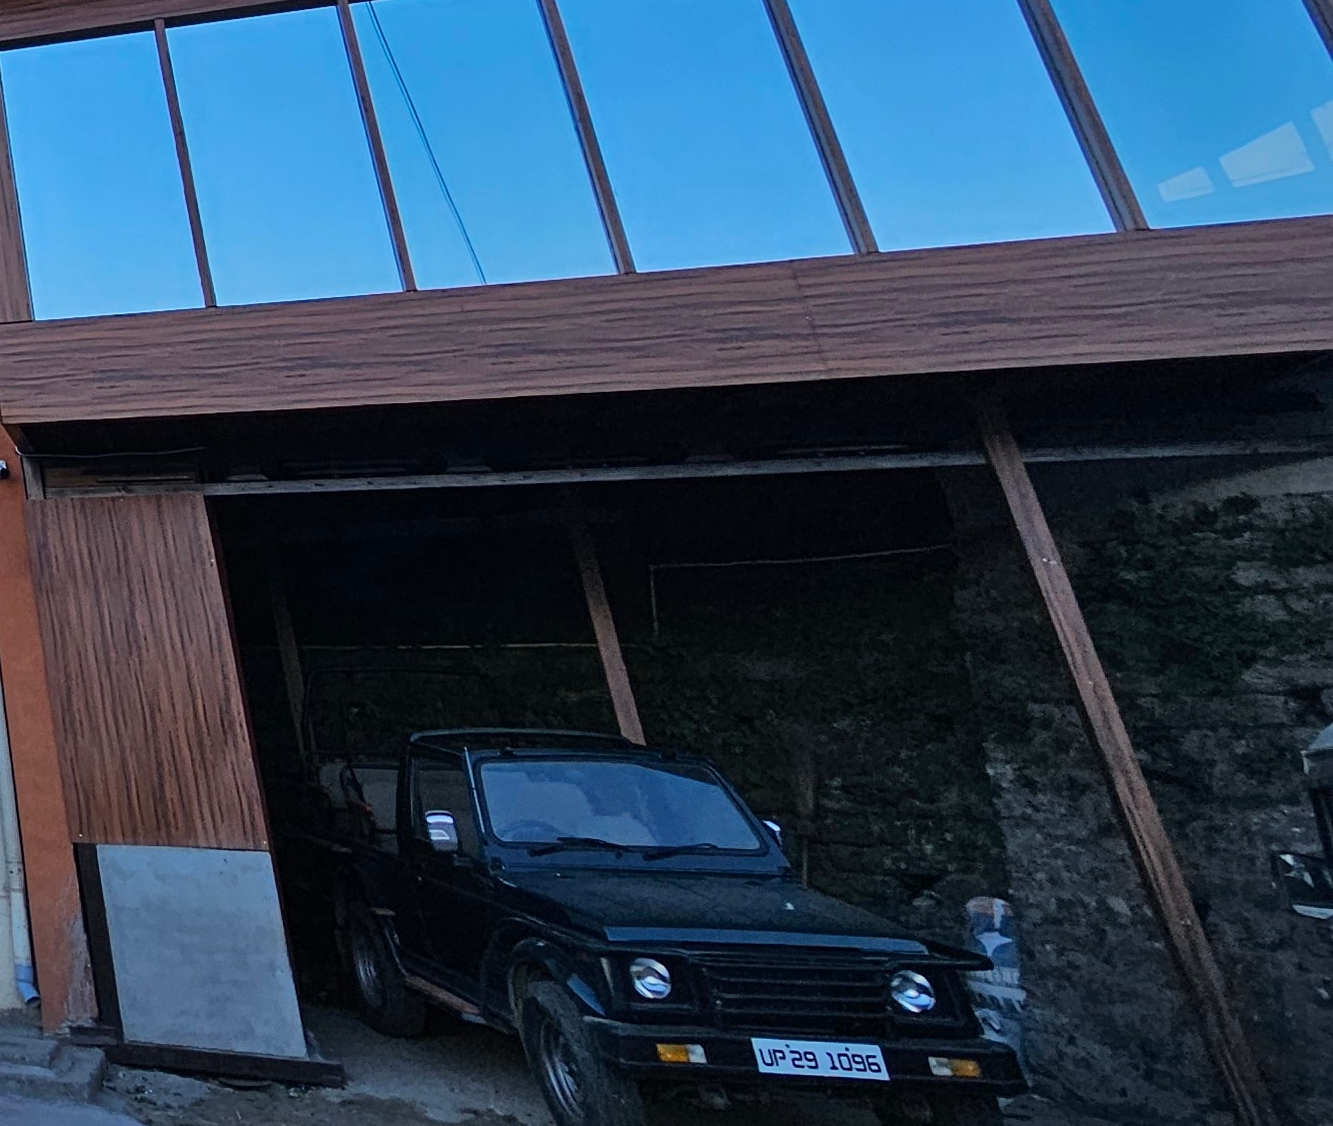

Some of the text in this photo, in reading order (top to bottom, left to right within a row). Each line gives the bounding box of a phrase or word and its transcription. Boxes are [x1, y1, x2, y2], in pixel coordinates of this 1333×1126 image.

[759, 1048, 882, 1073] UP 29 1096
